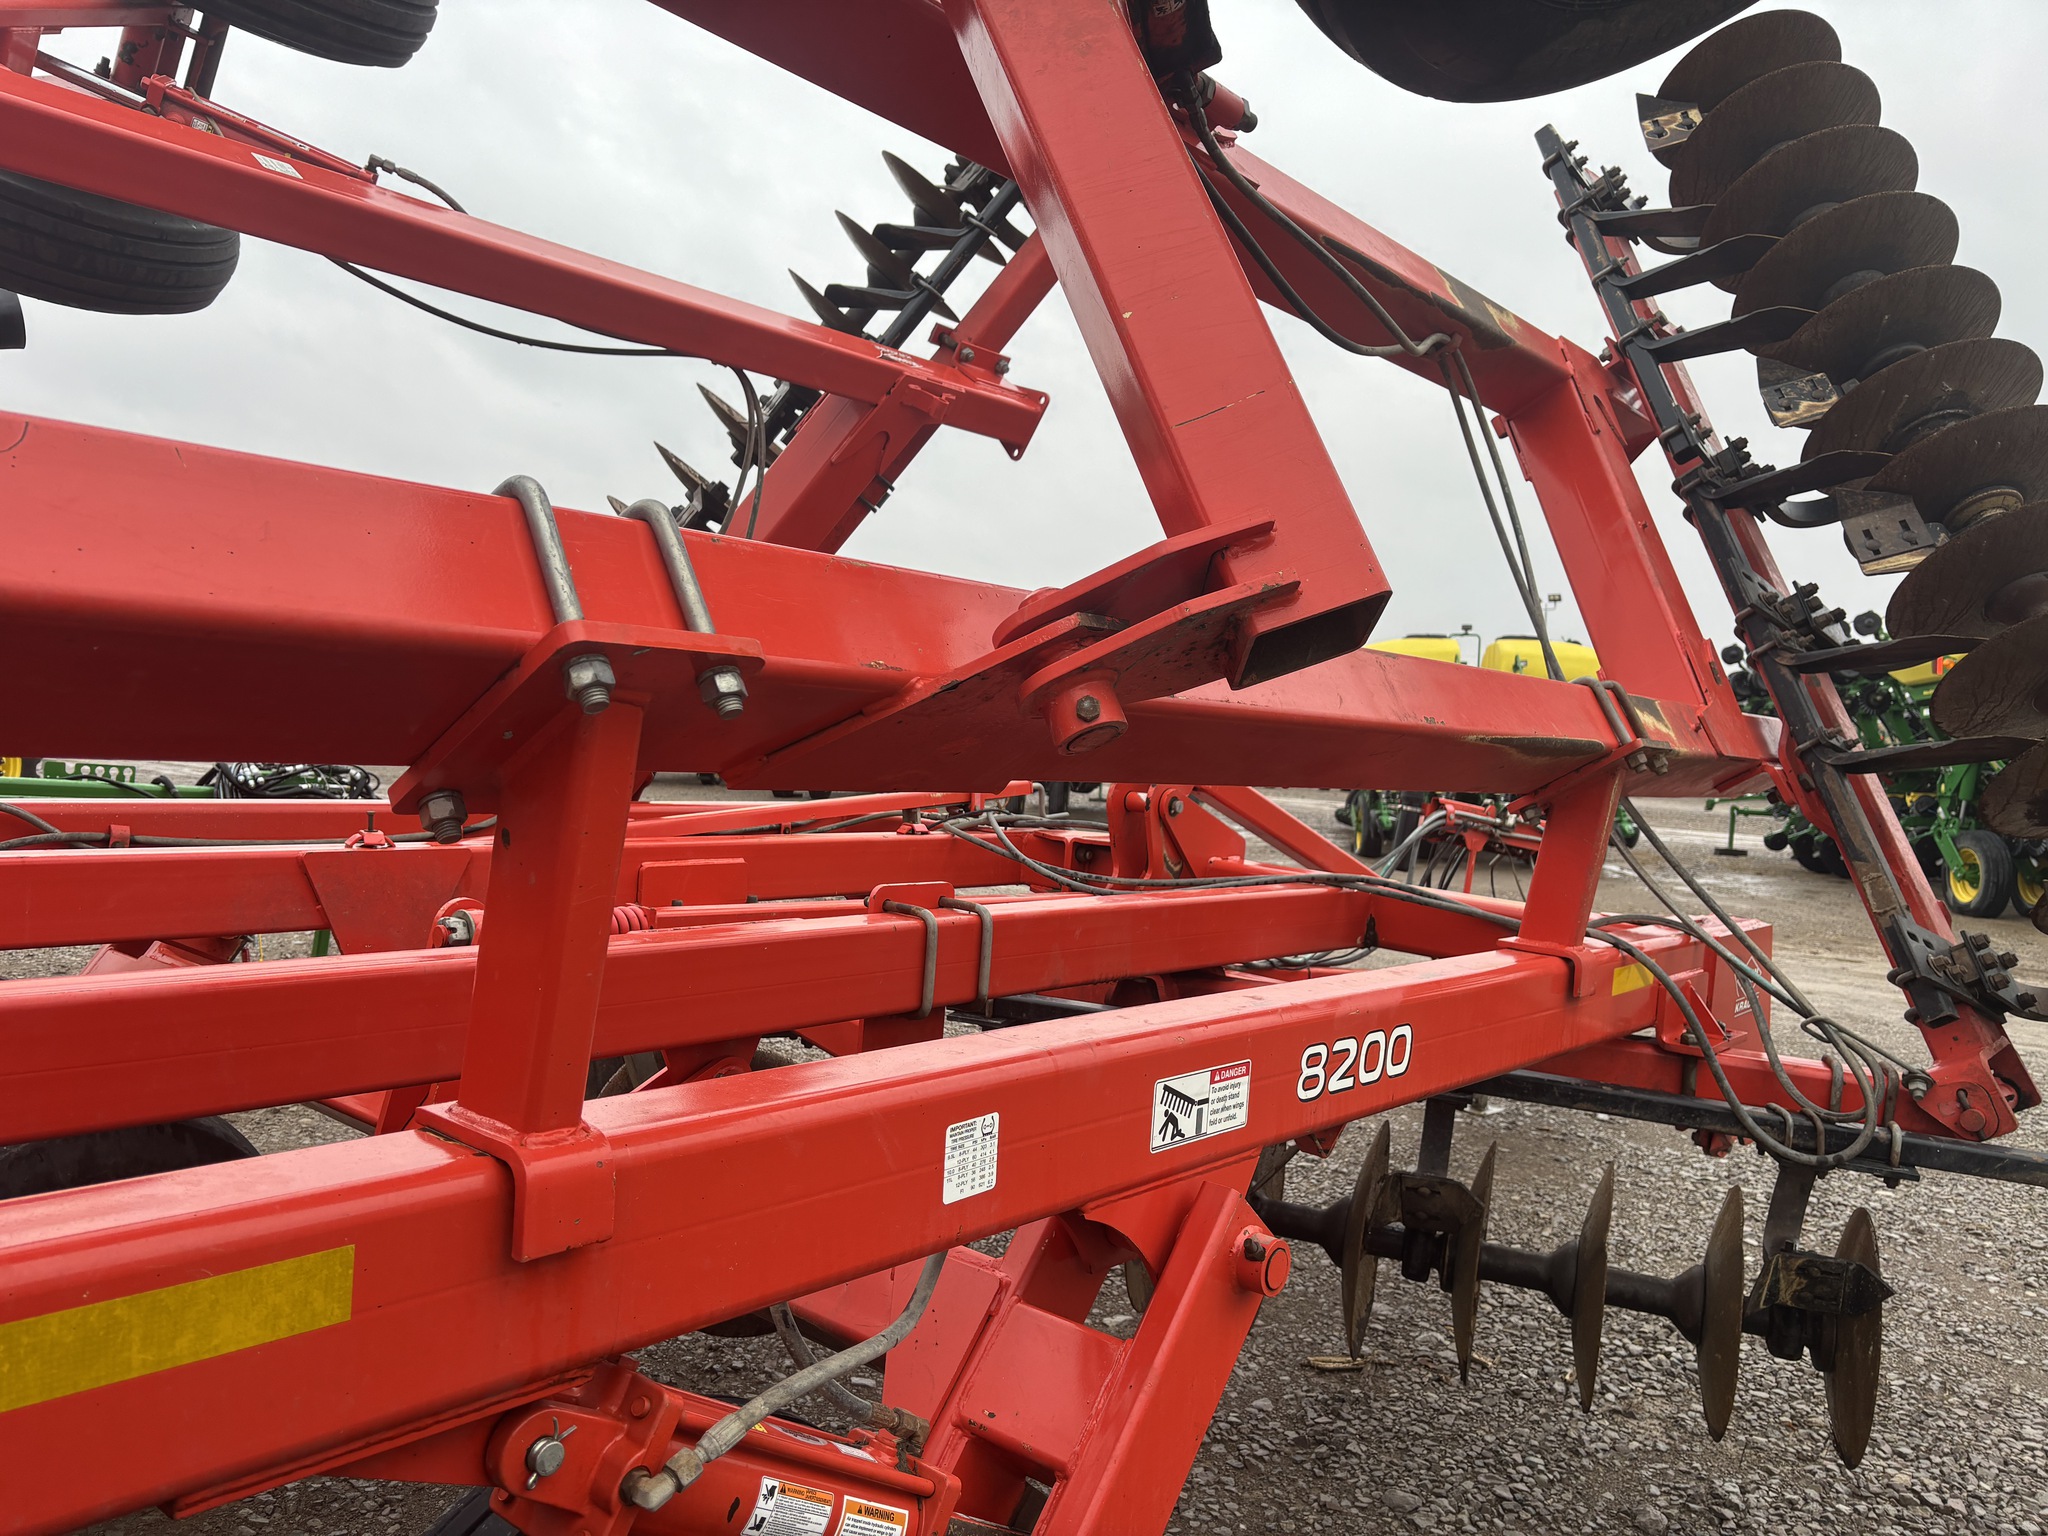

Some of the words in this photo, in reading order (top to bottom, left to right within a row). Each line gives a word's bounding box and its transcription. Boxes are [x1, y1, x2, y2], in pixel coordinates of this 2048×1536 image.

[1296, 1023, 1414, 1103] 8200
[1220, 1066, 1247, 1080] DANGER
[1218, 1083, 1229, 1092] avoid
[1230, 1082, 1242, 1090] injury
[1216, 1094, 1228, 1104] death
[1228, 1091, 1240, 1100] stand
[1210, 1108, 1220, 1116] clear
[1220, 1104, 1232, 1113] when
[1232, 1101, 1244, 1110] wings
[1208, 1118, 1217, 1126] fold
[1223, 1112, 1238, 1123] unfold.
[950, 1120, 977, 1132] IMPORTANT:
[958, 1133, 975, 1141] PRESSURE
[787, 1487, 805, 1496] WARNING
[864, 1506, 895, 1522] WARNING
